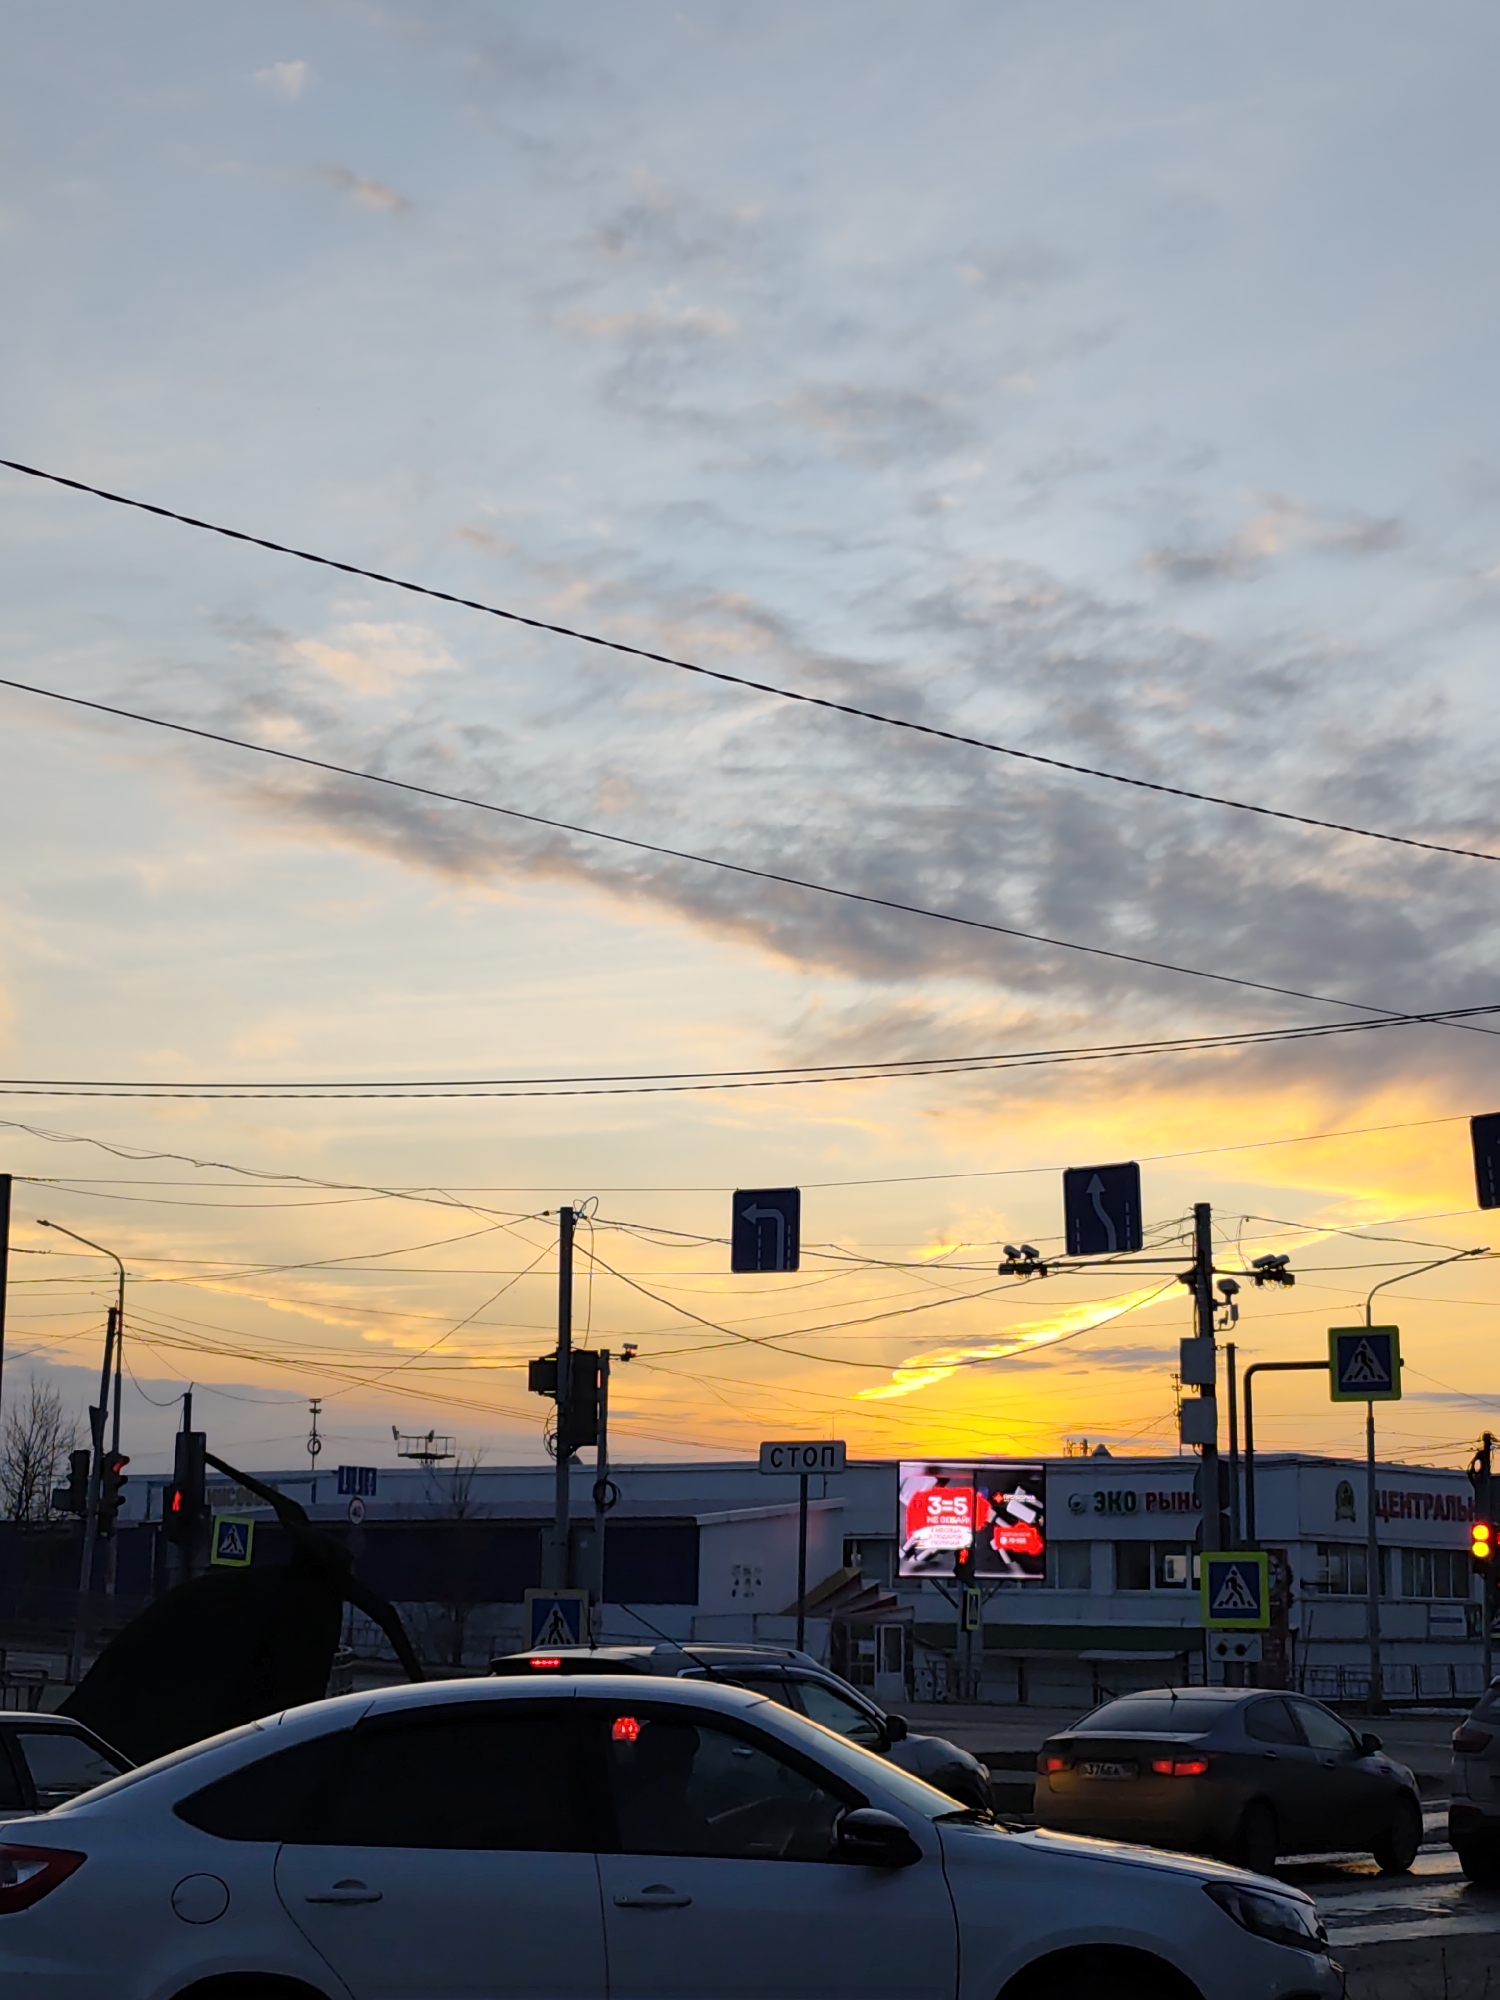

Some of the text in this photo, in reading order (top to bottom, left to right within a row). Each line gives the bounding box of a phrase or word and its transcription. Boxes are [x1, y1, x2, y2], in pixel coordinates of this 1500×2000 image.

[770, 1446, 835, 1468] СТОП
[927, 1496, 968, 1515] 3=5
[1093, 1489, 1137, 1512] ЭКО
